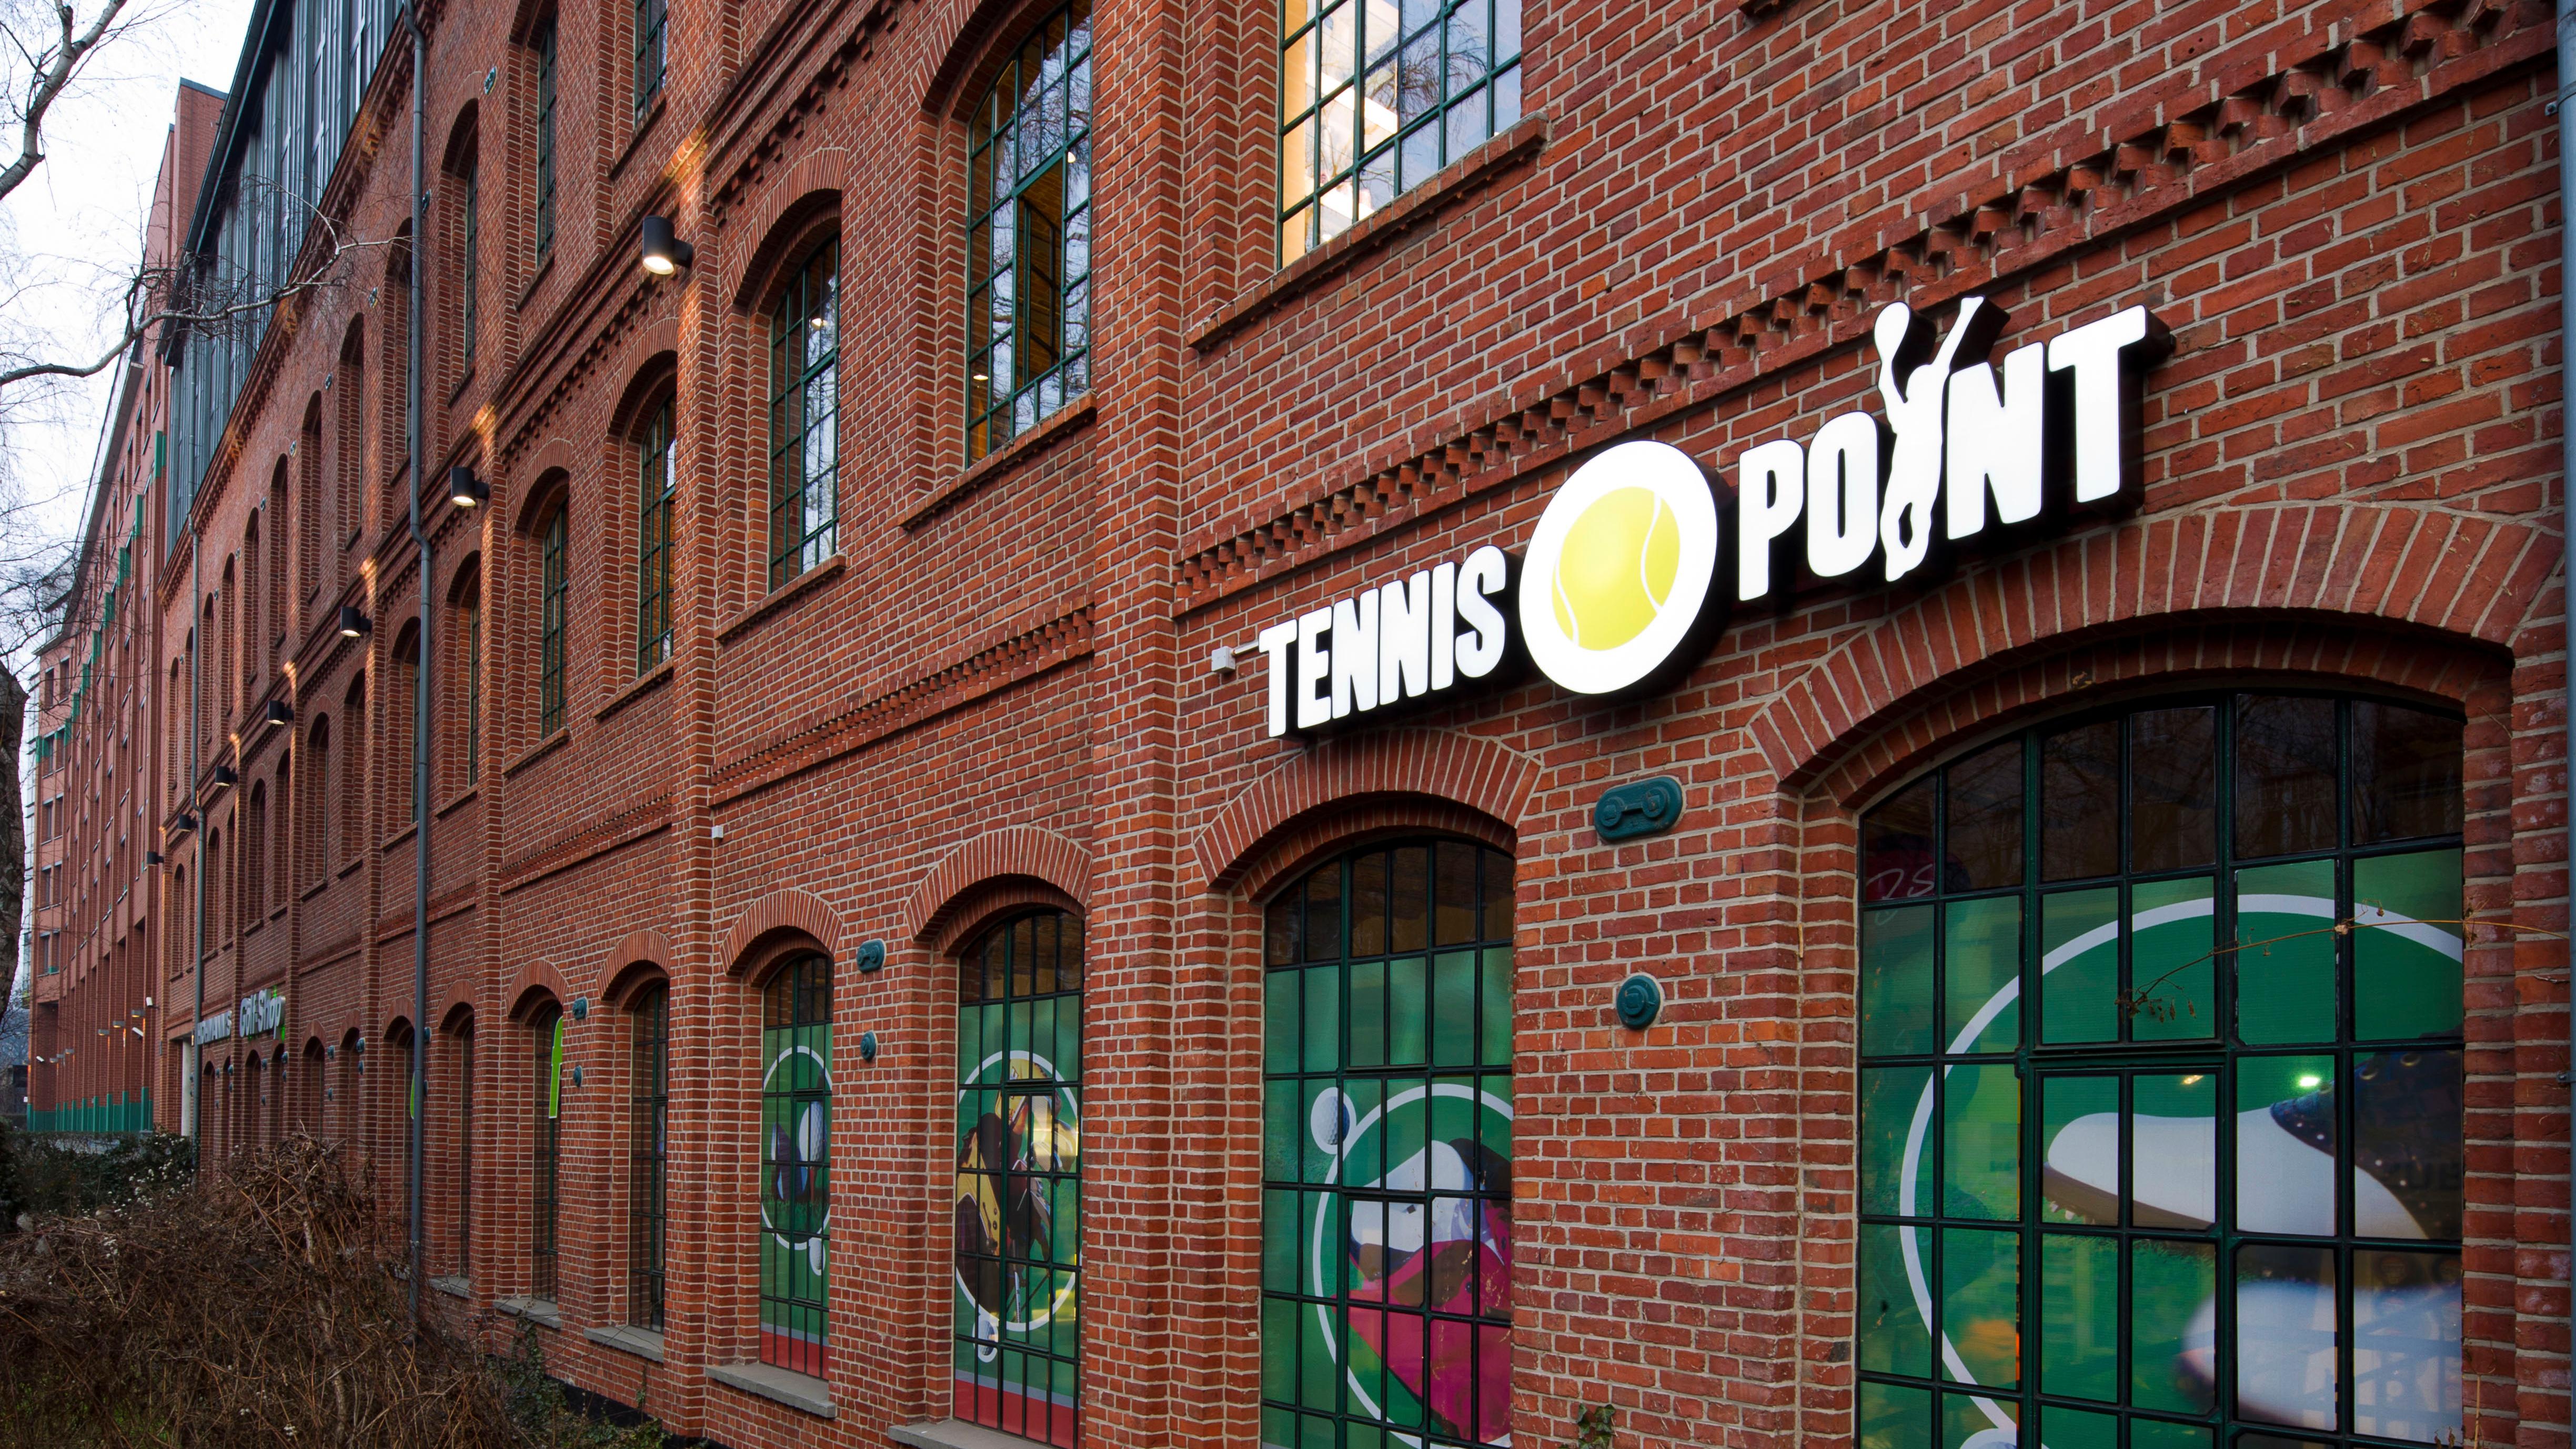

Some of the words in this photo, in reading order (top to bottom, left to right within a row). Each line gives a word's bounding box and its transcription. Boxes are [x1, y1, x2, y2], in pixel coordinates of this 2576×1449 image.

[1259, 546, 1506, 737] TENNIS
[1739, 297, 2146, 600] POINT
[239, 989, 283, 1040] Golf-Shop
